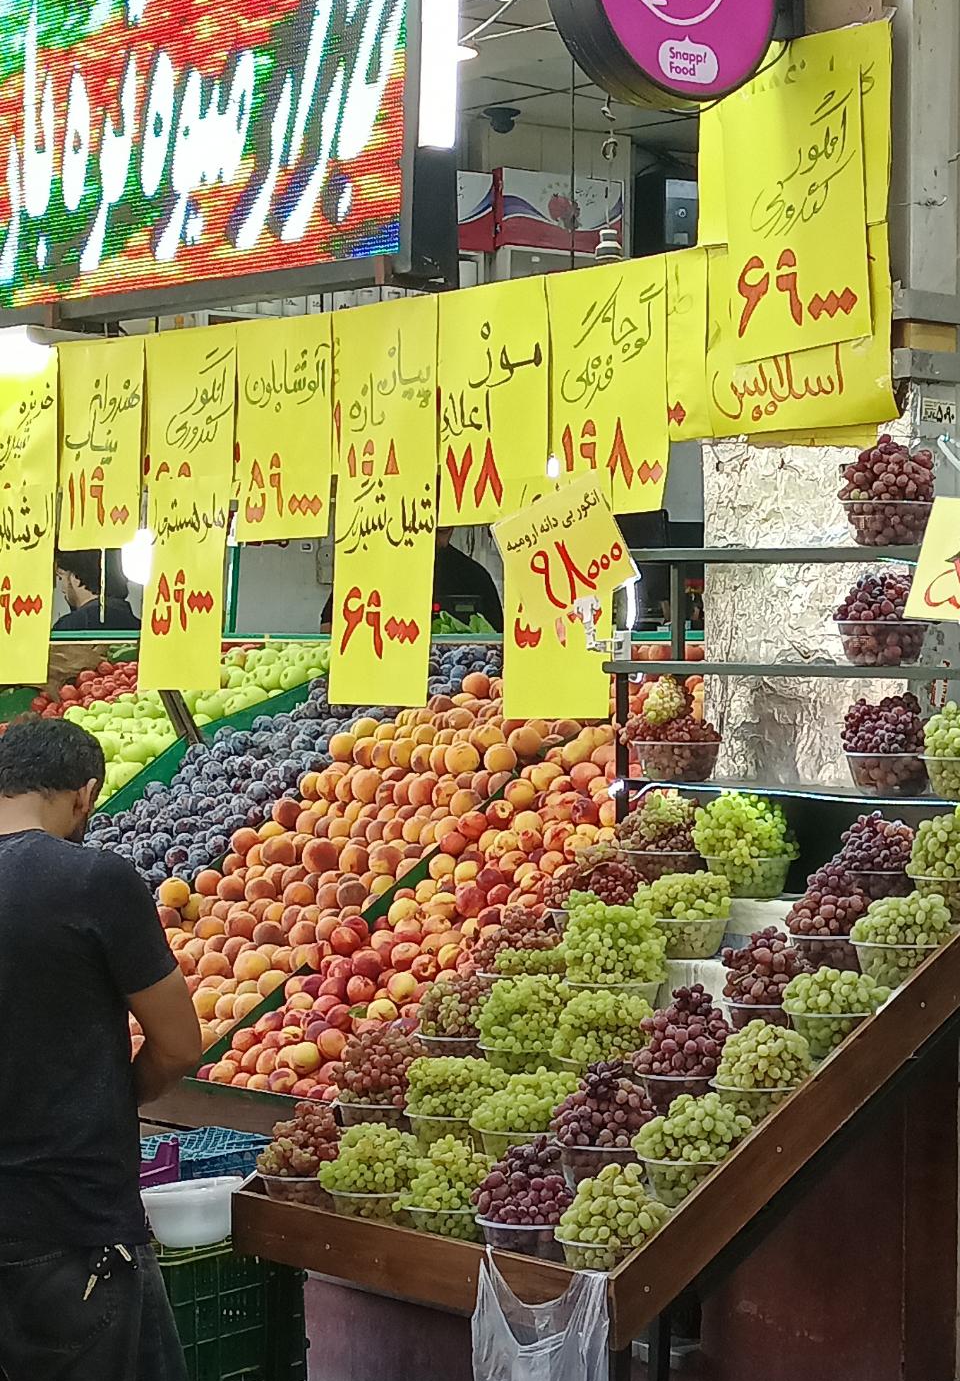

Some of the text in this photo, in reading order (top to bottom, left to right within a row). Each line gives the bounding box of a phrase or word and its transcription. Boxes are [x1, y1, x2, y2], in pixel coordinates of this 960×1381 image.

[669, 46, 707, 66] Snapp!
[669, 61, 696, 77] Food
[738, 248, 858, 339] ۶۹۰۰۰
[468, 321, 542, 389] موز
[245, 452, 323, 524] ۵۹۰۰۰
[561, 509, 576, 529] بی
[578, 489, 601, 521] انگور
[506, 523, 540, 553] ارومیه
[539, 515, 559, 534] دانه
[151, 569, 214, 636] ۵۹۰۰۰
[340, 585, 420, 659] ۶۹۰۰۰
